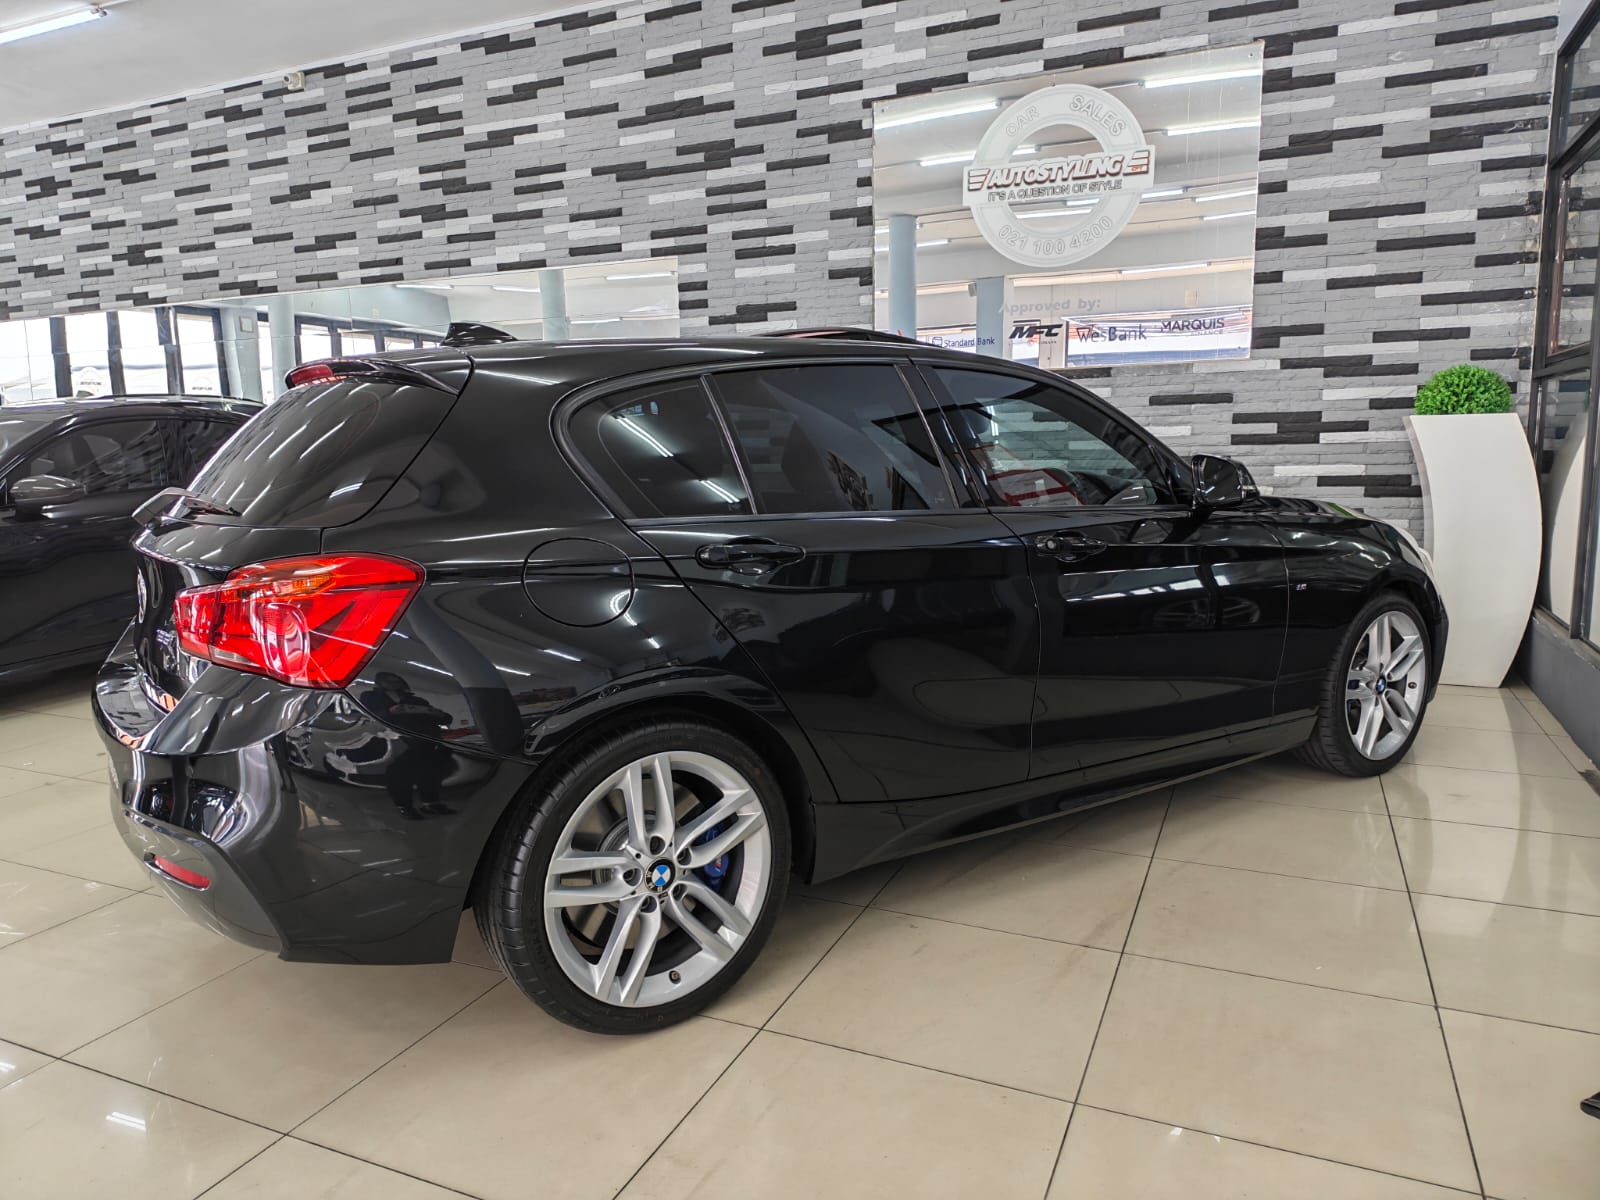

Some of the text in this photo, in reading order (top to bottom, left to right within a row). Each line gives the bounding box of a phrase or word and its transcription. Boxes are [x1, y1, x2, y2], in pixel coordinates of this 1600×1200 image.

[1006, 95, 1127, 136] CAR SALES
[987, 155, 1124, 188] AUTOSTYLING
[988, 179, 1123, 202] IT'S A QUESTION OF STYLE
[999, 215, 1113, 256] 021 100 4200
[999, 299, 1102, 316] Approved by:
[1009, 323, 1063, 339] MFC
[1076, 323, 1148, 343] WesBank
[1161, 317, 1225, 333] MARQUIS
[944, 336, 976, 348] Standard
[977, 336, 996, 346] Bank
